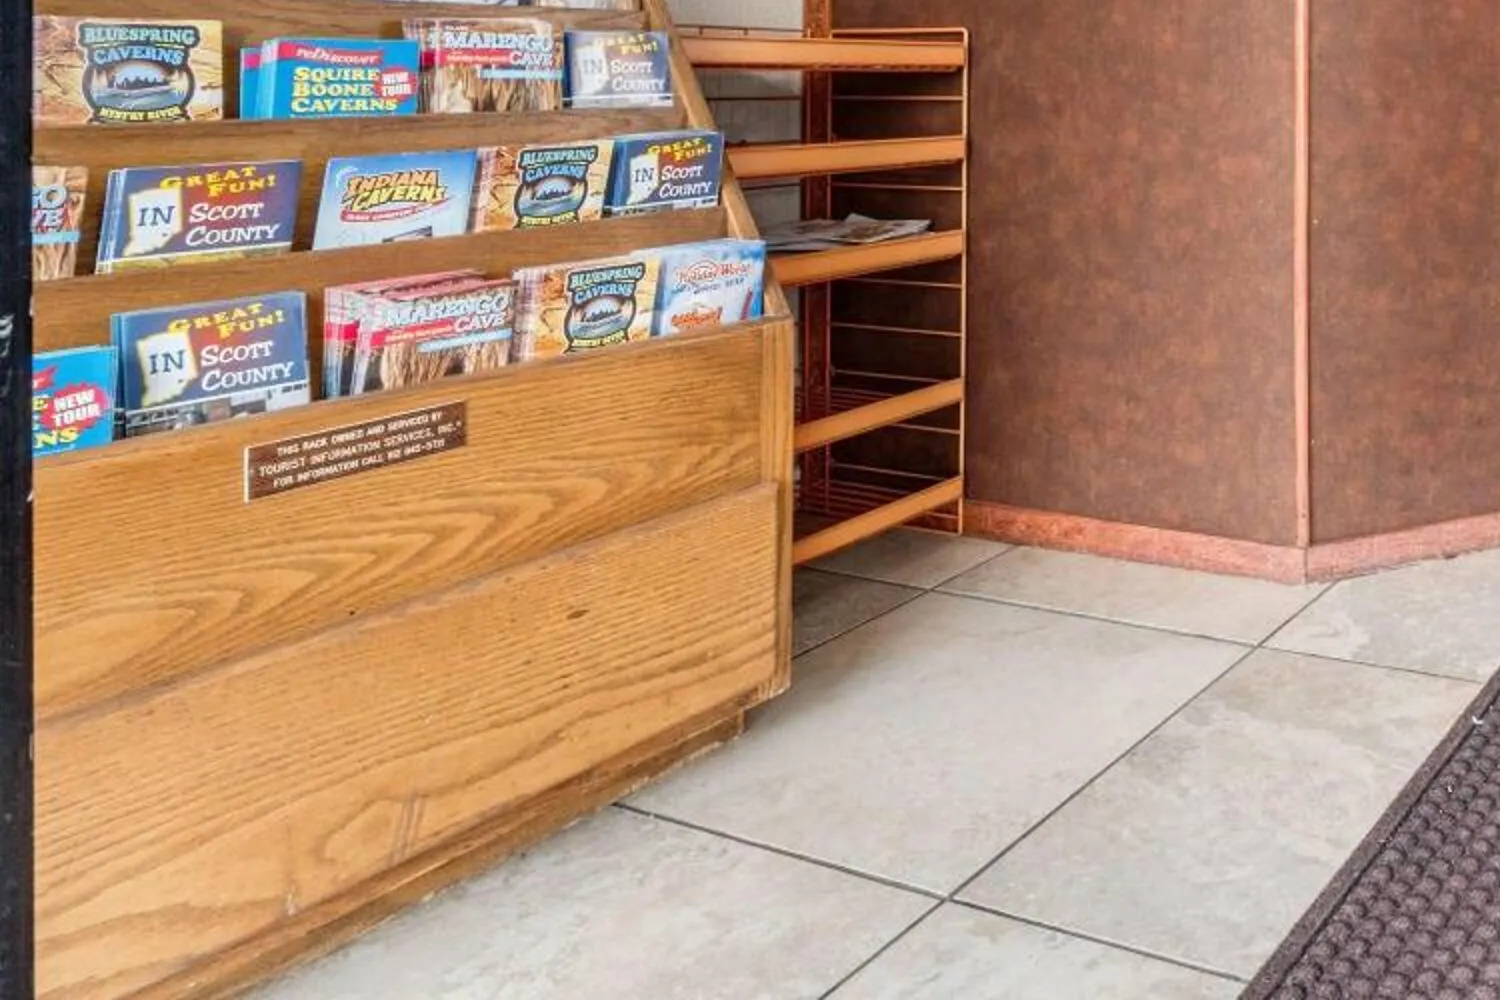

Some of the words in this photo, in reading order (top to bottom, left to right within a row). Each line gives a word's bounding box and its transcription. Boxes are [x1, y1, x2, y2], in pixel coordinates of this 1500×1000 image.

[84, 26, 195, 45] BLUESPRING
[443, 31, 553, 52] MARENGO
[93, 46, 185, 66] CAVERNS
[583, 59, 606, 75] IN
[292, 83, 375, 98] BOONE
[291, 98, 398, 113] CAVERNS
[522, 147, 596, 165] BLUESPRING
[647, 137, 704, 155] GREAT
[160, 165, 257, 191] GREAT
[347, 169, 440, 194] INDIANA
[525, 164, 587, 182] CAVERNS
[635, 167, 655, 183] IN
[661, 164, 705, 180] SCOTT
[208, 173, 277, 198] FUN!
[659, 181, 713, 198] COUNTY
[351, 184, 447, 212] CAVERNS
[137, 205, 176, 227] IN
[189, 201, 265, 225] SCOTT
[185, 223, 281, 247] COUNTY
[571, 264, 643, 289] BLUESPRING
[574, 281, 635, 303] CAVERNS
[168, 301, 265, 336] GREAT
[384, 293, 509, 327] MARENGO
[217, 309, 286, 341] FUN!
[455, 313, 506, 333] CAVE
[149, 349, 186, 375] IN
[200, 340, 274, 367] SCOTT
[201, 361, 295, 391] COUNTY
[53, 388, 96, 413] NEW
[52, 402, 101, 428] TOUR
[276, 442, 300, 457] THIS
[302, 437, 328, 451] RACK
[366, 423, 386, 437] AND
[387, 414, 430, 432] SERVICED
[258, 456, 306, 478] TOURIST
[309, 439, 382, 466] INFORMATION
[272, 474, 294, 489] FOR
[297, 458, 360, 482] INFORMATION
[361, 452, 384, 467] CALL
